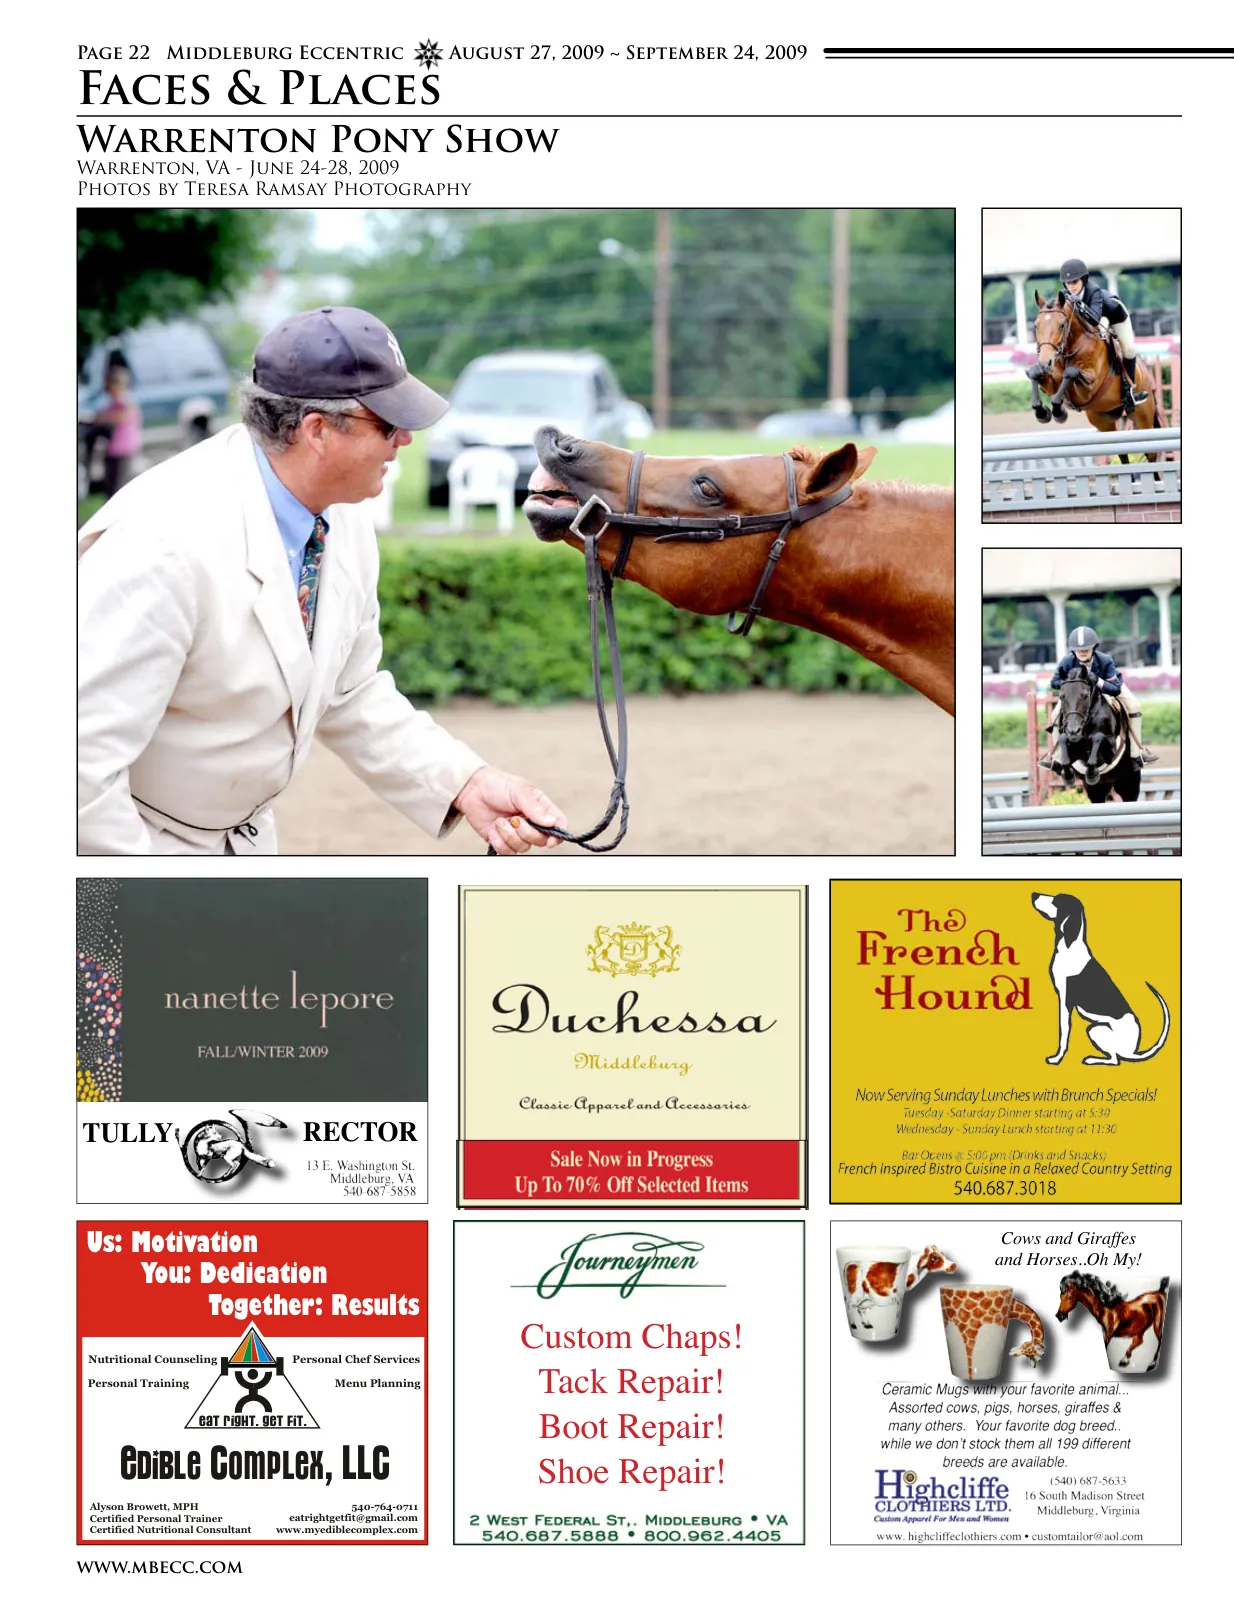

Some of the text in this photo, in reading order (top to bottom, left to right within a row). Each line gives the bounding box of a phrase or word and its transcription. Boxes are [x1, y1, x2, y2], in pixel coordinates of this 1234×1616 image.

[77, 44, 808, 62] PAGE 22 MIDDLEBURG ECCENTRIC AUGUST 27, 2009 SEPTEMBER 24, 2009
[78, 67, 441, 106] FACES & PLACES
[75, 123, 561, 154] WARRENTON PONY SHOW
[76, 159, 400, 179] WARRENTON, VA JUNE 24-28, 2009
[77, 180, 473, 197] PHOTOS BY TERESA RAMSAY PHOTOGRAPHY
[896, 908, 967, 933] The
[856, 928, 1021, 967] French
[164, 969, 394, 1029] nanette lepore
[874, 974, 1034, 1011] Hound
[491, 983, 778, 1035] Duchessa
[197, 1045, 329, 1059] FALL/WINTER 2009
[573, 1052, 693, 1077] Middleburg
[82, 1121, 419, 1144] TULLY RECTOR
[307, 1159, 415, 1174] 13 E. Washington St.
[550, 1149, 714, 1172] Sale Now in Progress
[330, 1172, 414, 1187] Middleburg, VA
[343, 1184, 417, 1197] 540-687-5858
[953, 1179, 1057, 1196] 540.687.3018
[86, 1229, 258, 1253] Us: Motivation
[1001, 1230, 1137, 1249] Cows and Giraffes
[140, 1261, 328, 1285] You: Dedication
[537, 1232, 705, 1299] Journeymen
[208, 1292, 421, 1321] Together: Results
[520, 1322, 741, 1356] Custom Chaps!
[538, 1367, 723, 1402] Tack Repair!
[538, 1412, 723, 1447] Boot Repair!
[538, 1457, 724, 1492] Shoe Repair!
[1049, 1476, 1127, 1487] (540) 687-5633
[874, 1469, 1010, 1504] Highcliffe
[88, 1501, 199, 1513] Alyson Browett, MPH
[351, 1502, 419, 1513] 540-764-0711
[874, 1499, 1012, 1513] CLOTHIERS LTD.
[288, 1512, 419, 1524] eatrightgetfit@gmail.com
[275, 1524, 419, 1536] www.myediblecomplex.com
[76, 1560, 244, 1575] WWW.MBECC.COM
